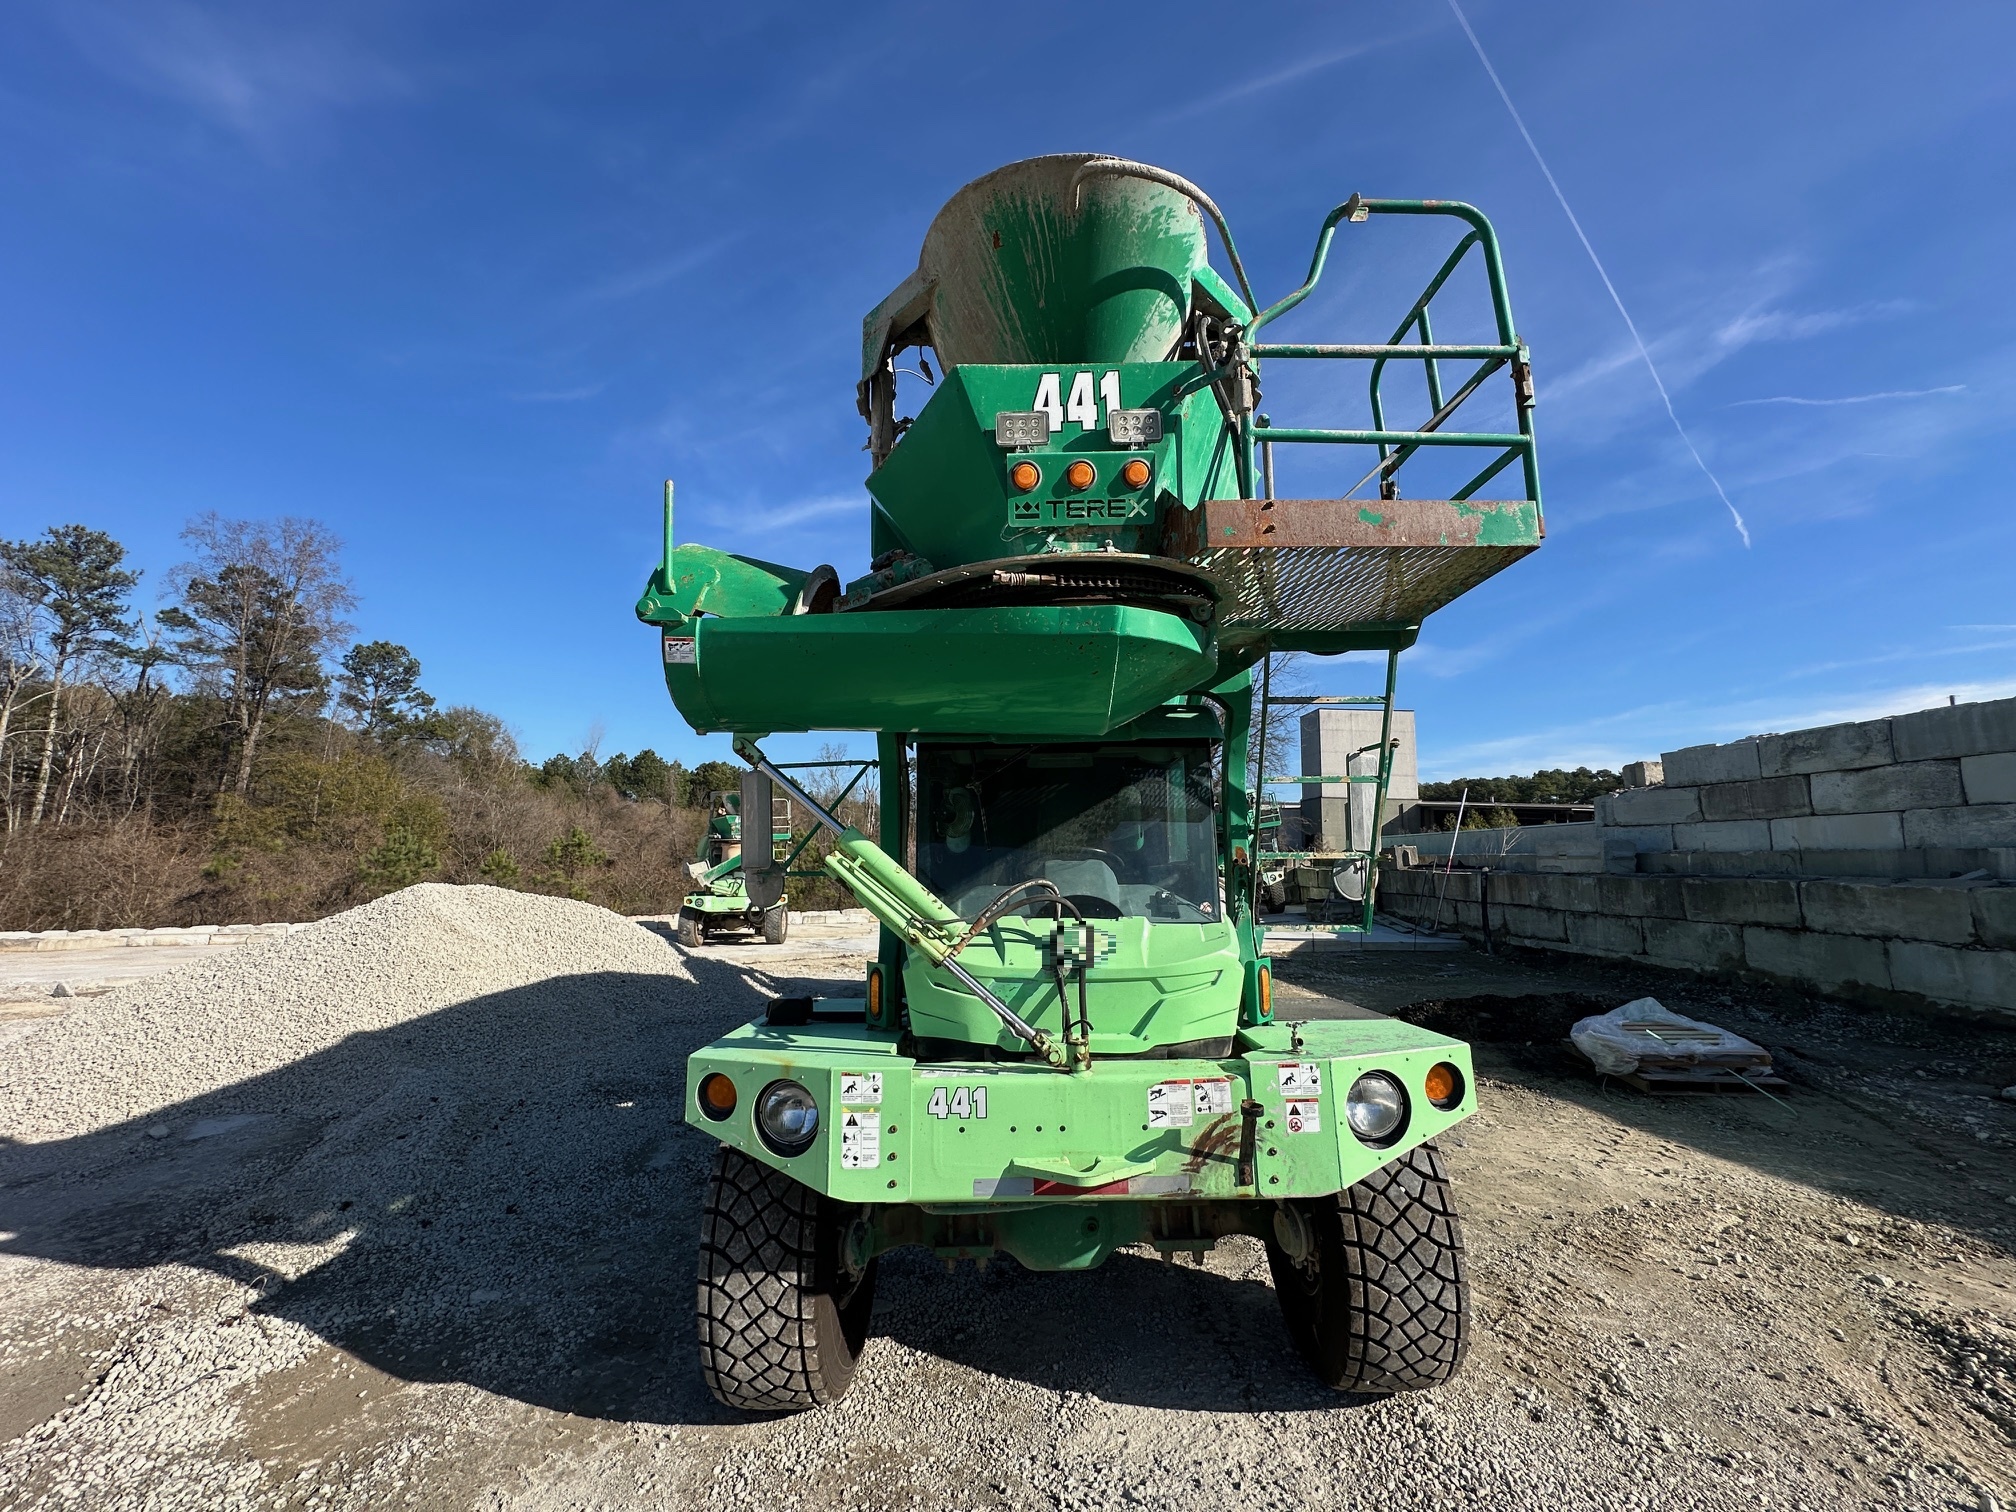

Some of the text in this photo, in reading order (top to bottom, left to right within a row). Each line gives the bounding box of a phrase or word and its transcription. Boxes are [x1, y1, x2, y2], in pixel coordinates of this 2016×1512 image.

[1032, 370, 1122, 432] 441
[1046, 498, 1149, 519] TEREX
[927, 1086, 987, 1119] 441
